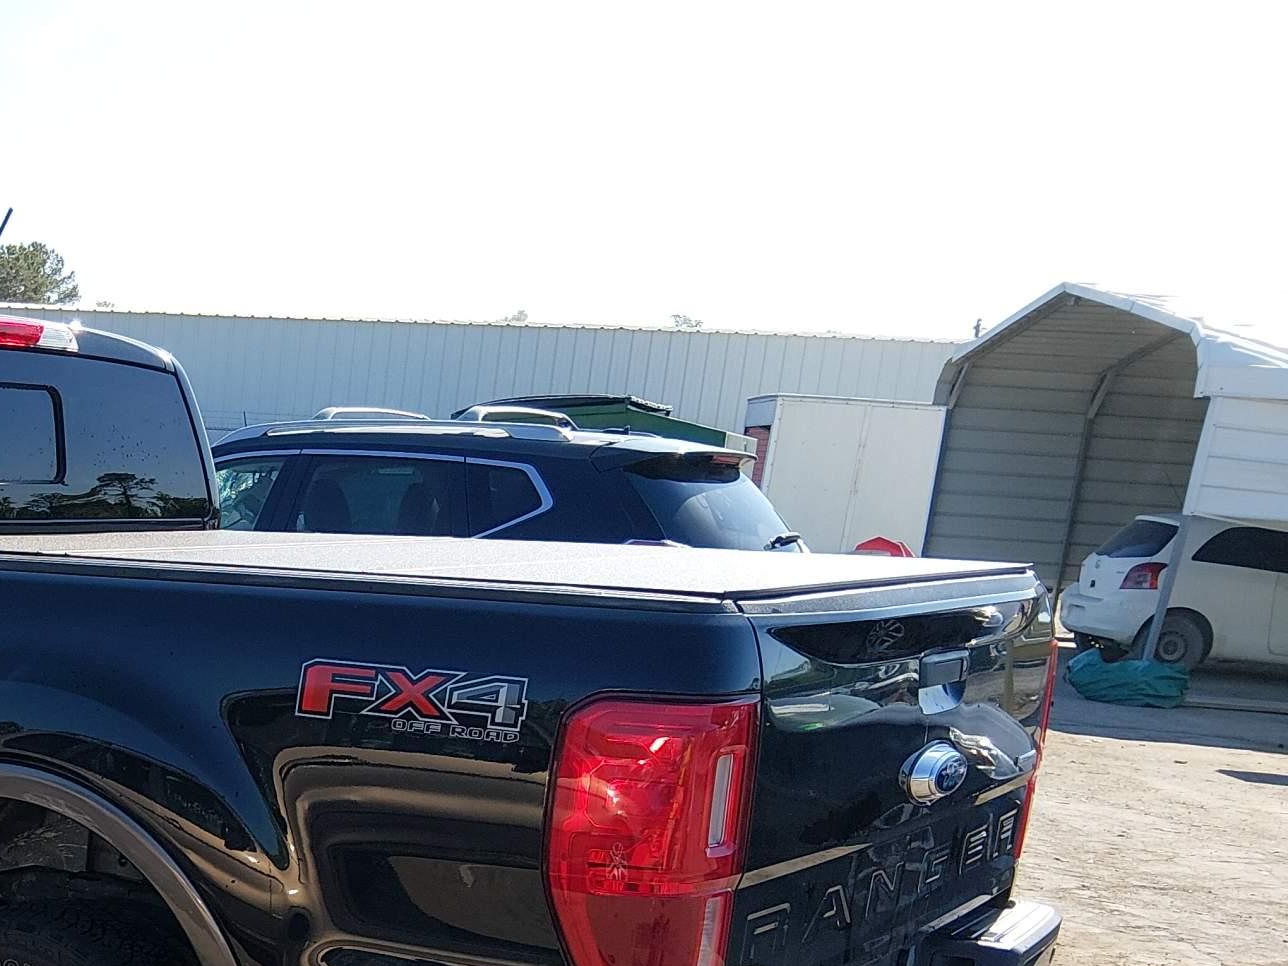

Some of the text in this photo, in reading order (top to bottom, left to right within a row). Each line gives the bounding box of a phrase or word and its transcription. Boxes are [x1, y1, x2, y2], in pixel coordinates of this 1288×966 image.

[295, 658, 529, 731] FX4
[391, 719, 520, 743] OFF ROAD
